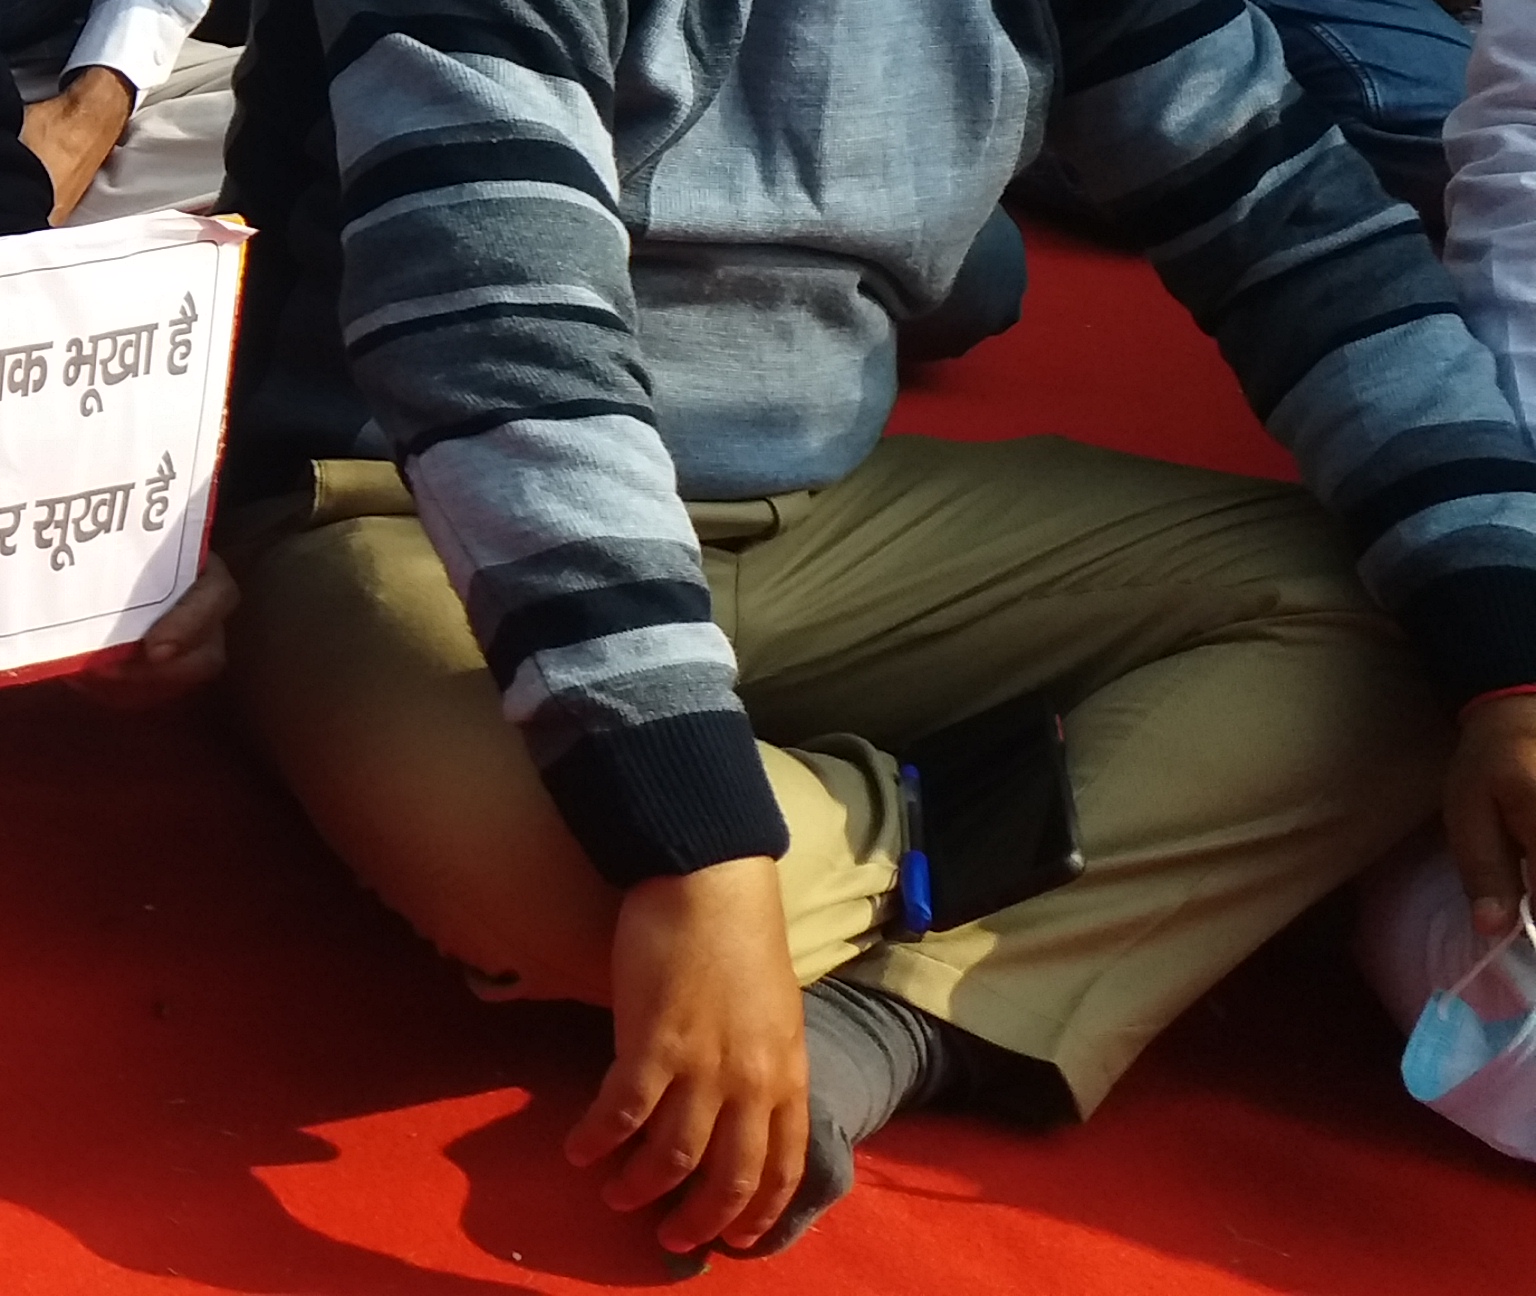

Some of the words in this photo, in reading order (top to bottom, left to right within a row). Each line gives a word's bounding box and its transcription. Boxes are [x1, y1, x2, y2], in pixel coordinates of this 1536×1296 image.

[65, 323, 158, 417] भूखा
[166, 291, 197, 377] है
[34, 482, 134, 571] सूखा
[142, 451, 177, 532] है
